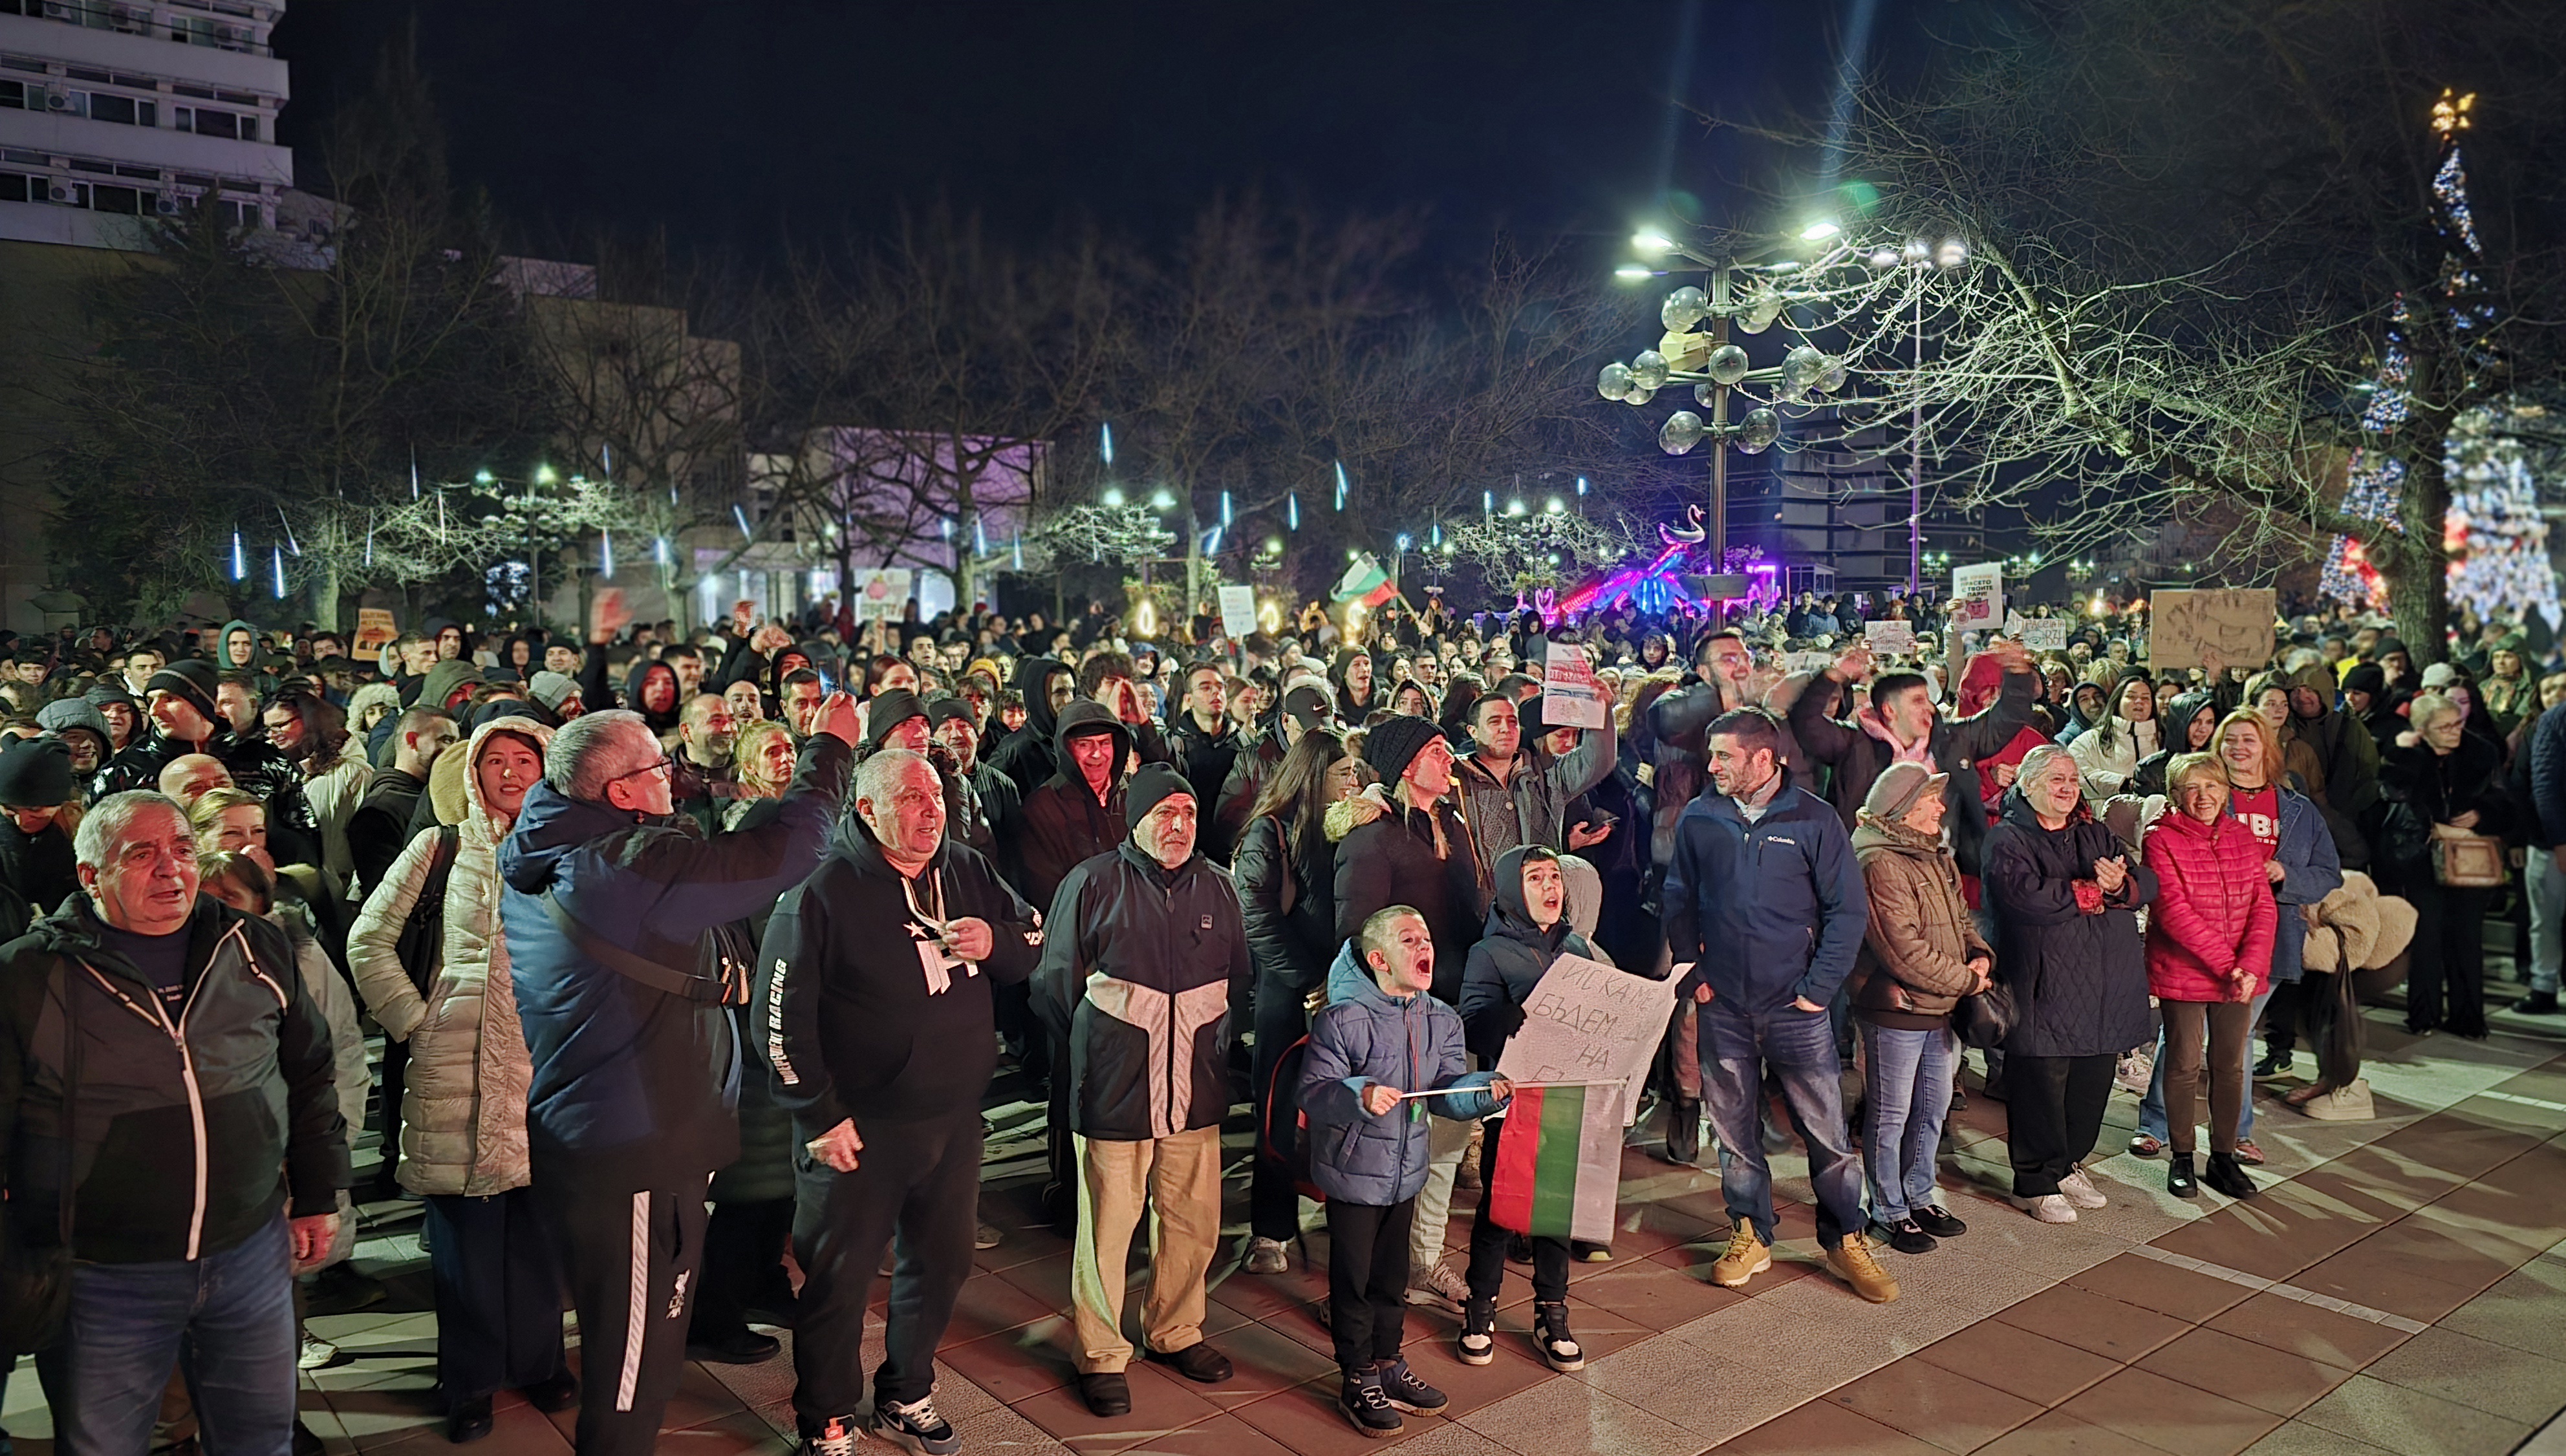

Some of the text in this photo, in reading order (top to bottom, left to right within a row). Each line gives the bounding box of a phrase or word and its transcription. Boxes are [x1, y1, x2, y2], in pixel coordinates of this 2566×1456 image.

[768, 958, 787, 1030] RACING
[1561, 961, 1659, 1010] ИСКАМЕ
[1533, 993, 1619, 1037] БЪДЕМ
[1575, 1044, 1609, 1071] НА
